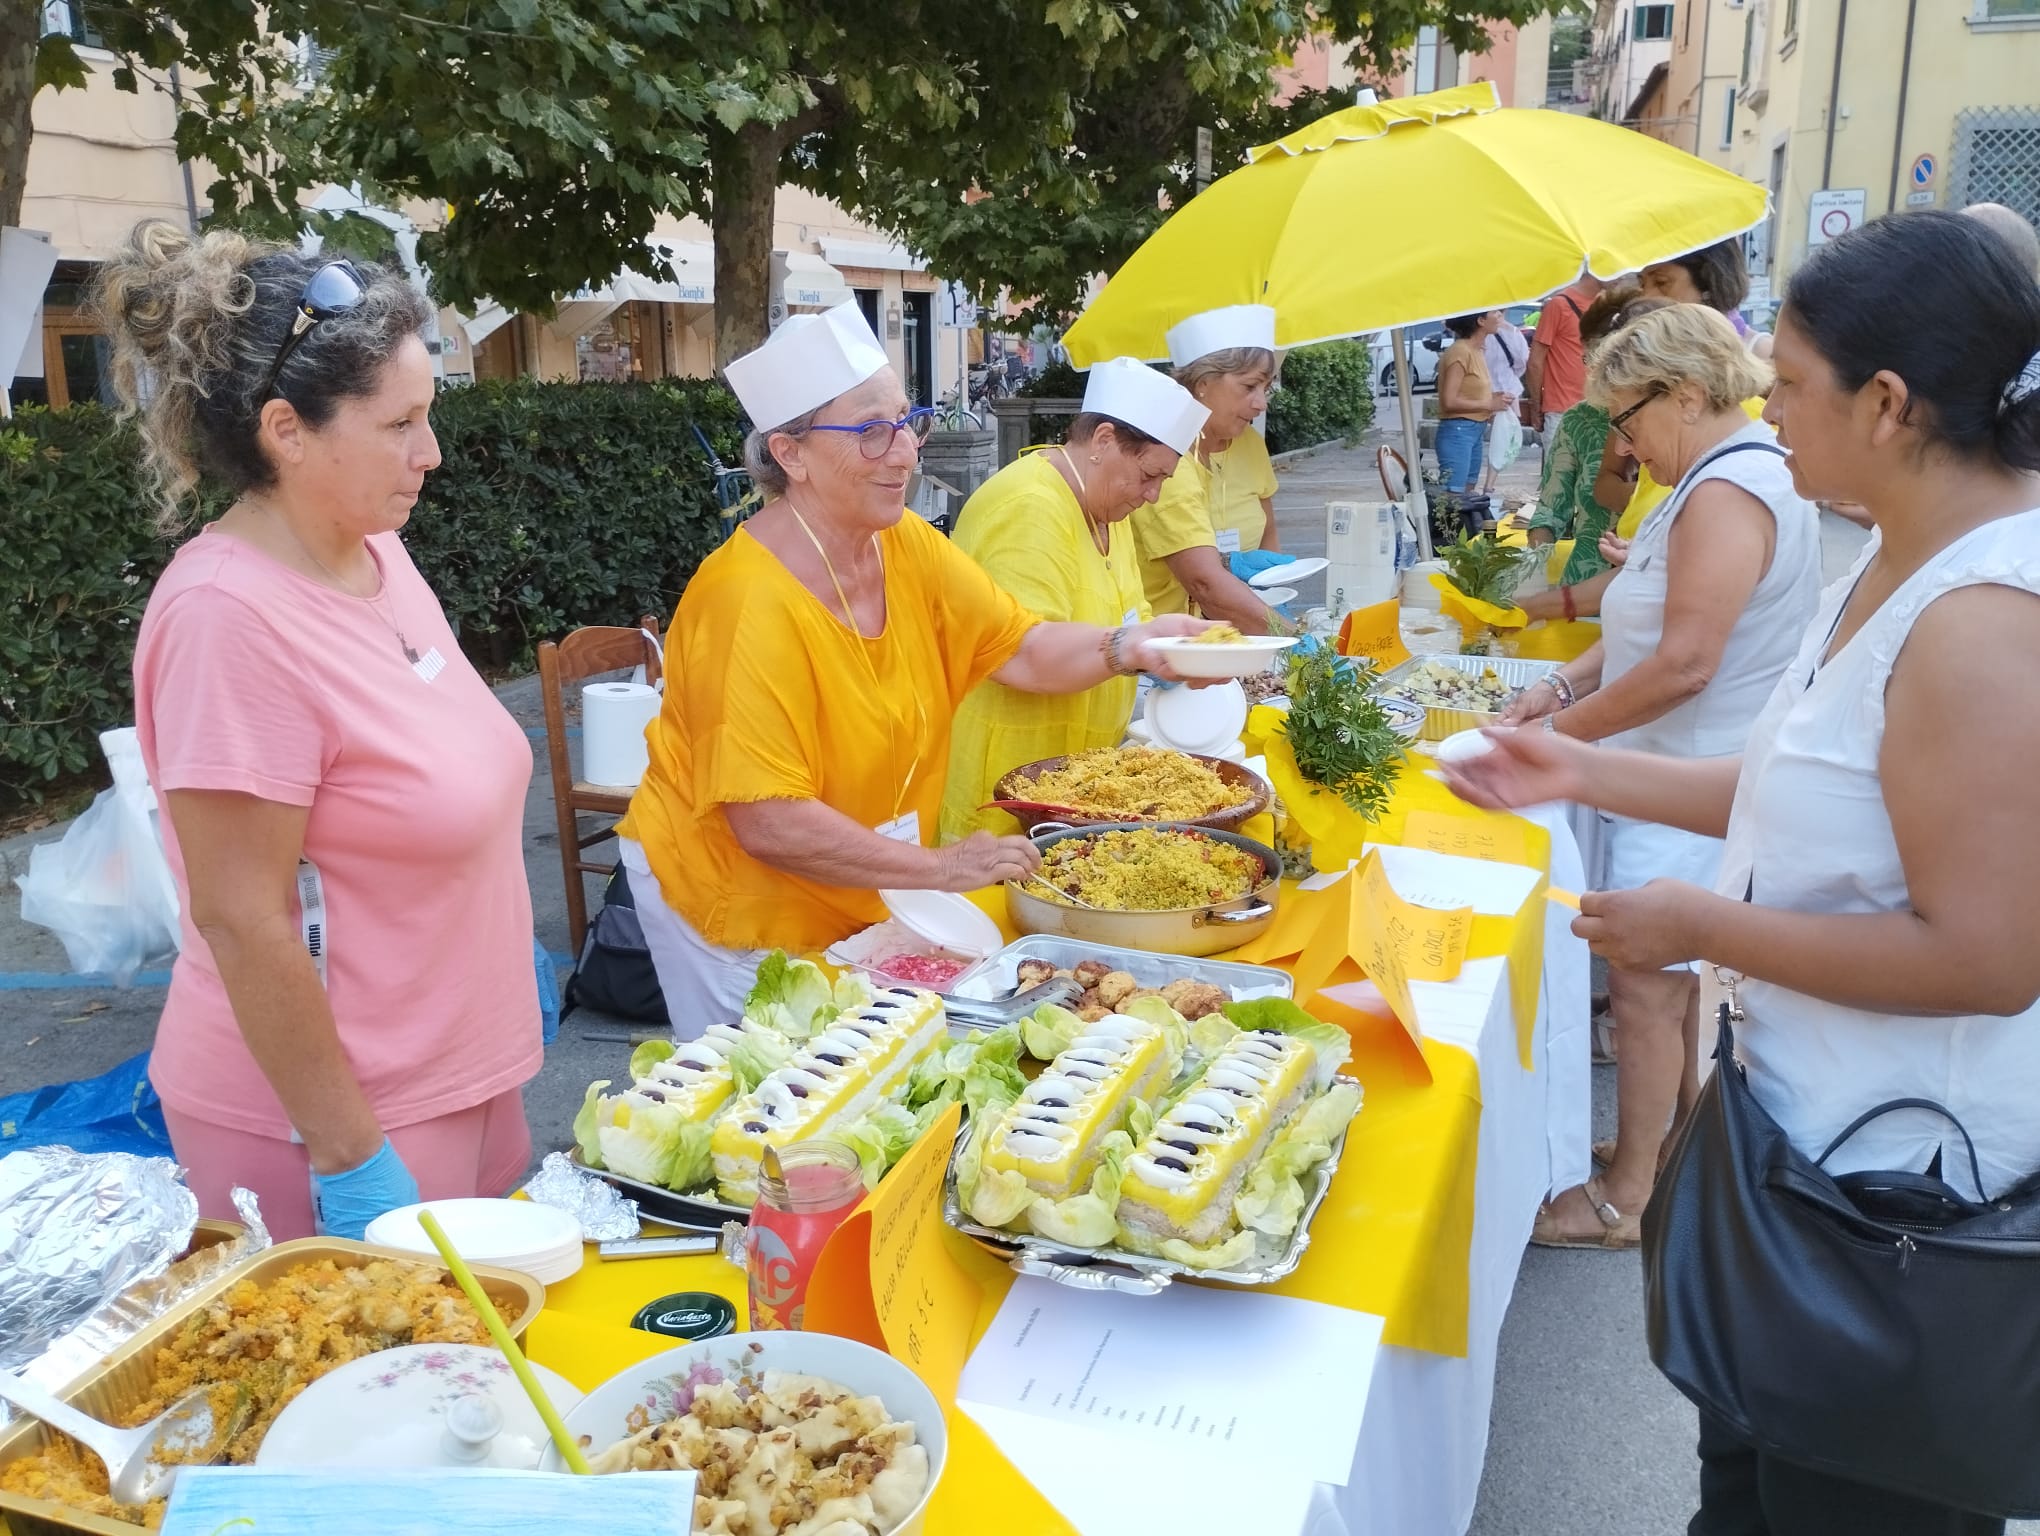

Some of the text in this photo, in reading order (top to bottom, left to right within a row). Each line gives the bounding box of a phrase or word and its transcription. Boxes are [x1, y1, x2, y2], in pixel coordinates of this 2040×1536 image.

[678, 285, 705, 301] Bambi
[799, 290, 821, 304] Bambi
[308, 923, 322, 957] PUMA
